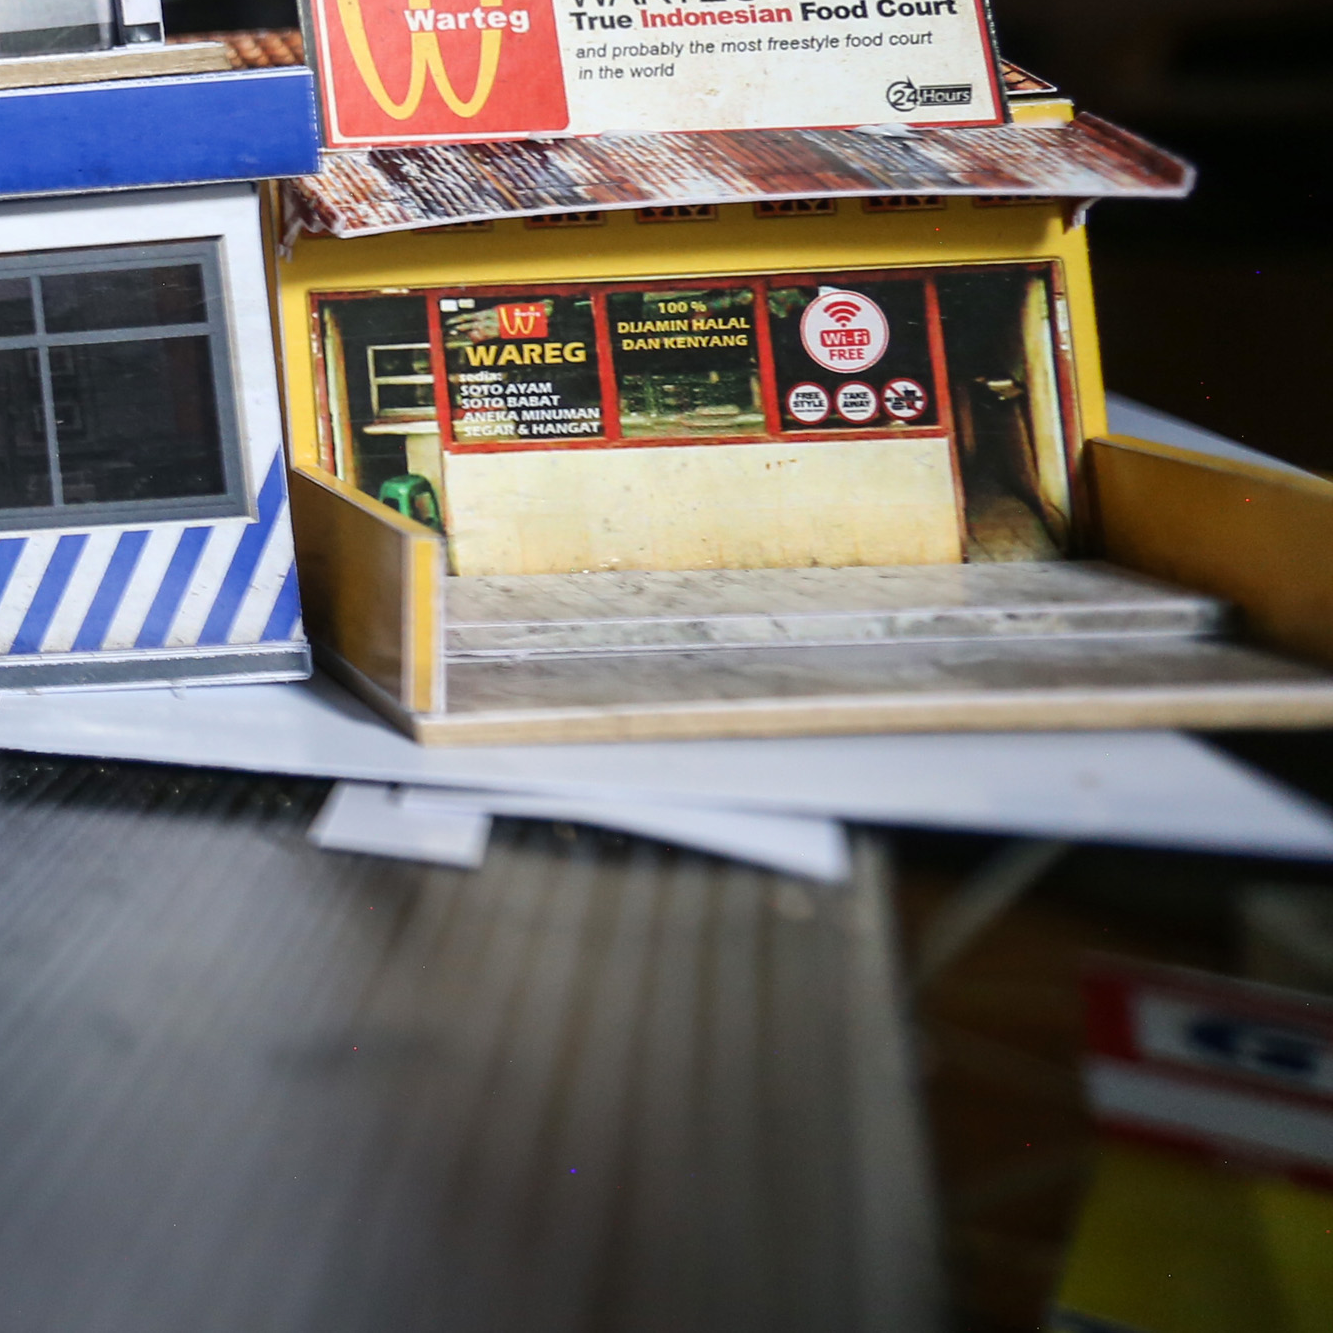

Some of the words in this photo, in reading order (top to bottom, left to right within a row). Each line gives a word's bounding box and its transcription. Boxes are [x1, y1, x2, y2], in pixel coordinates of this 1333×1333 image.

[404, 7, 530, 33] Warteg
[570, 11, 632, 32] True
[641, 4, 793, 29] Indonesian
[801, 0, 868, 22] Food
[576, 43, 607, 60] and
[612, 40, 682, 63] probably
[689, 39, 715, 56] the
[720, 38, 762, 54] most
[767, 33, 839, 54] freestyle
[845, 31, 883, 48] food
[889, 30, 933, 47] court
[579, 65, 593, 80] in
[598, 63, 625, 79] the
[630, 61, 674, 78] world
[892, 90, 918, 106] 24
[923, 89, 970, 103] Hours
[658, 302, 688, 314] 100
[691, 301, 707, 313] %
[617, 319, 688, 334] DIJAMIN
[692, 317, 751, 332] HALAL
[622, 337, 661, 351] DAN
[663, 334, 748, 349] KENYANG
[824, 331, 868, 345] Wi-Fi
[465, 341, 587, 366] WAREG
[829, 348, 865, 362] FREE
[459, 370, 503, 383] sedia:
[460, 383, 503, 396] SOTO
[505, 382, 553, 394] AYAM
[795, 391, 820, 400] FREE
[843, 391, 869, 400] TAKE
[461, 397, 505, 409] SOTO
[507, 395, 561, 407] BABAT
[793, 400, 825, 408] STYLE
[842, 400, 871, 408] AWAY
[463, 410, 519, 423] ANEKA
[522, 407, 601, 421] MINUMAN
[464, 424, 515, 437] SEGAR
[518, 423, 529, 435] &
[533, 421, 601, 435] HANGAT
